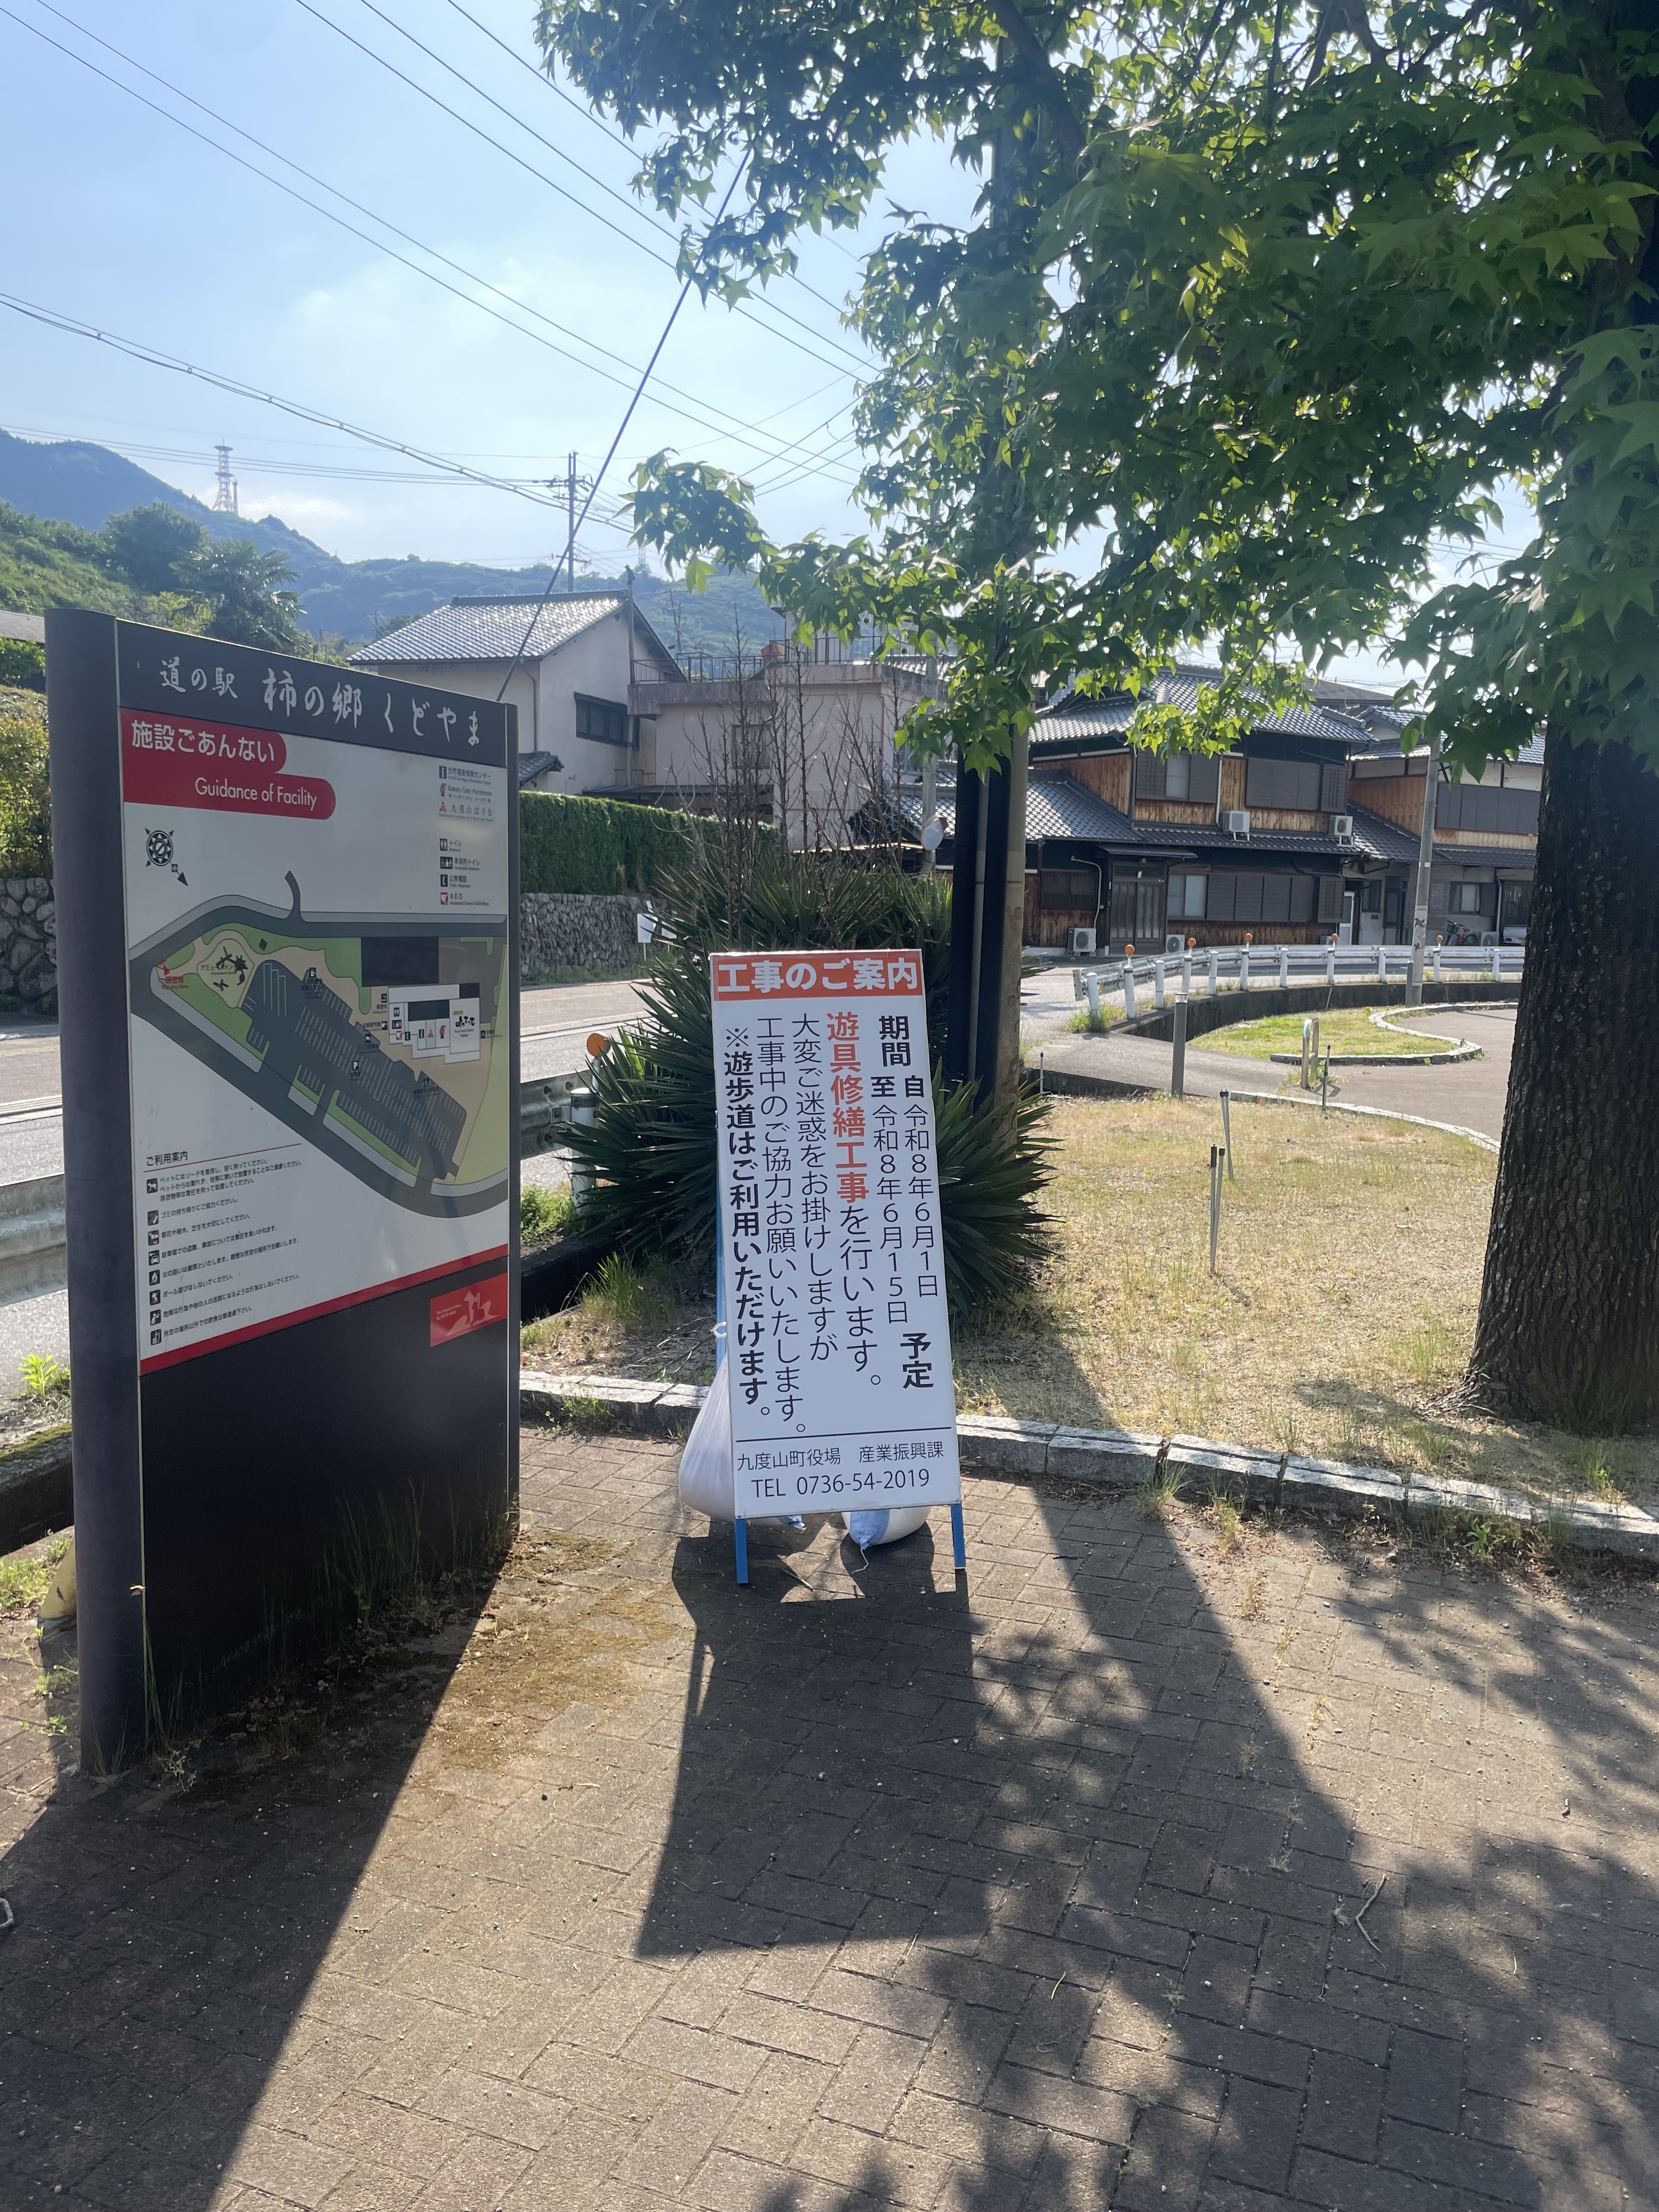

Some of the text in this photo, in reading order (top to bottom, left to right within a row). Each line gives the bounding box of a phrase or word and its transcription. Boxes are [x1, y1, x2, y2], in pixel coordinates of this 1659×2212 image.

[161, 657, 238, 699] 道の駅
[132, 720, 274, 763] 施設ごあんない
[195, 776, 317, 811] Guidance of Facility
[718, 957, 918, 994] 工事のご案内
[878, 1015, 911, 1067] 期間
[146, 1151, 188, 1166] ご利用案内
[791, 1013, 838, 1361] 大変ご迷惑をお掛けしますが
[724, 1028, 770, 1416] ※遊歩道はご利用いただけます。
[757, 1018, 806, 1432] 工事中のご協力お願いいたします。
[900, 1332, 934, 1389] 予定
[737, 1441, 944, 1472] 九度山町役場 産業振興課
[751, 1468, 930, 1498] TEL 0736-54-2019
